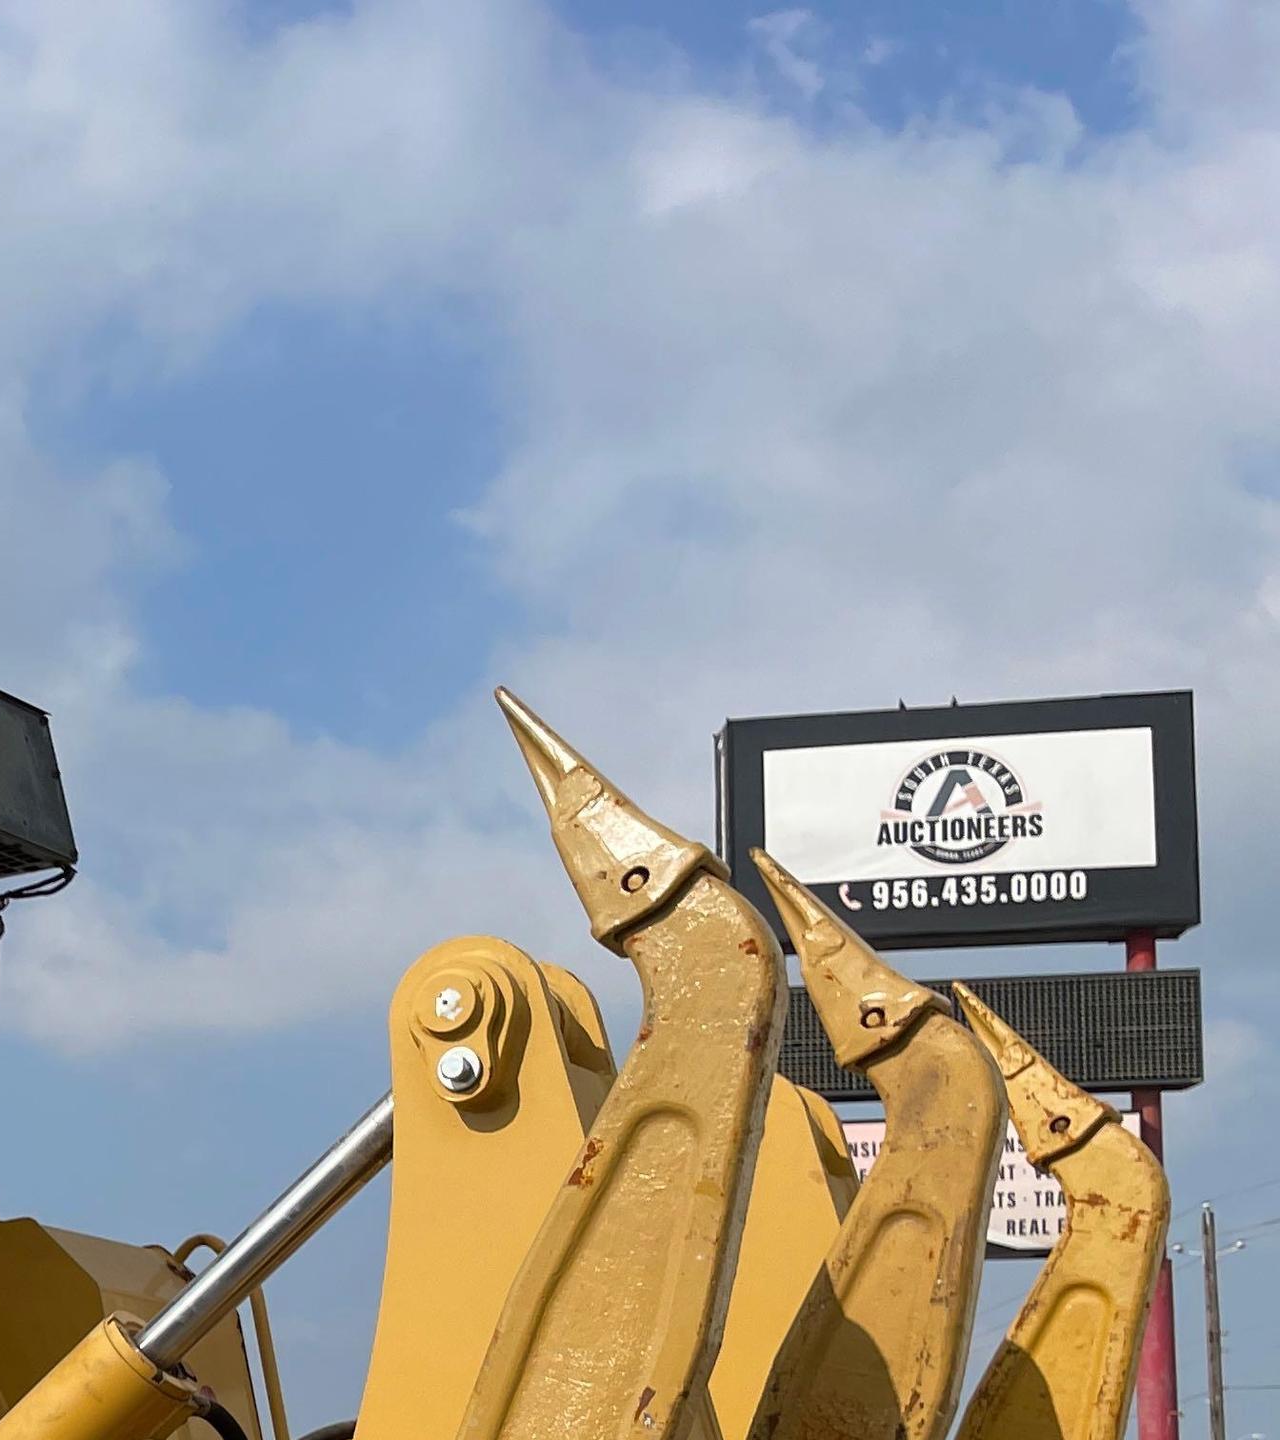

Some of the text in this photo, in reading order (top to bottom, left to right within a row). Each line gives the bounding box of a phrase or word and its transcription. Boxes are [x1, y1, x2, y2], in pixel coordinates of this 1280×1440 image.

[897, 750, 1019, 802] SOUTH TEXAS
[877, 814, 1044, 846] AUCTIONEERS
[872, 870, 1088, 911] 956.435.0000
[1006, 1218, 1051, 1236] REAL
